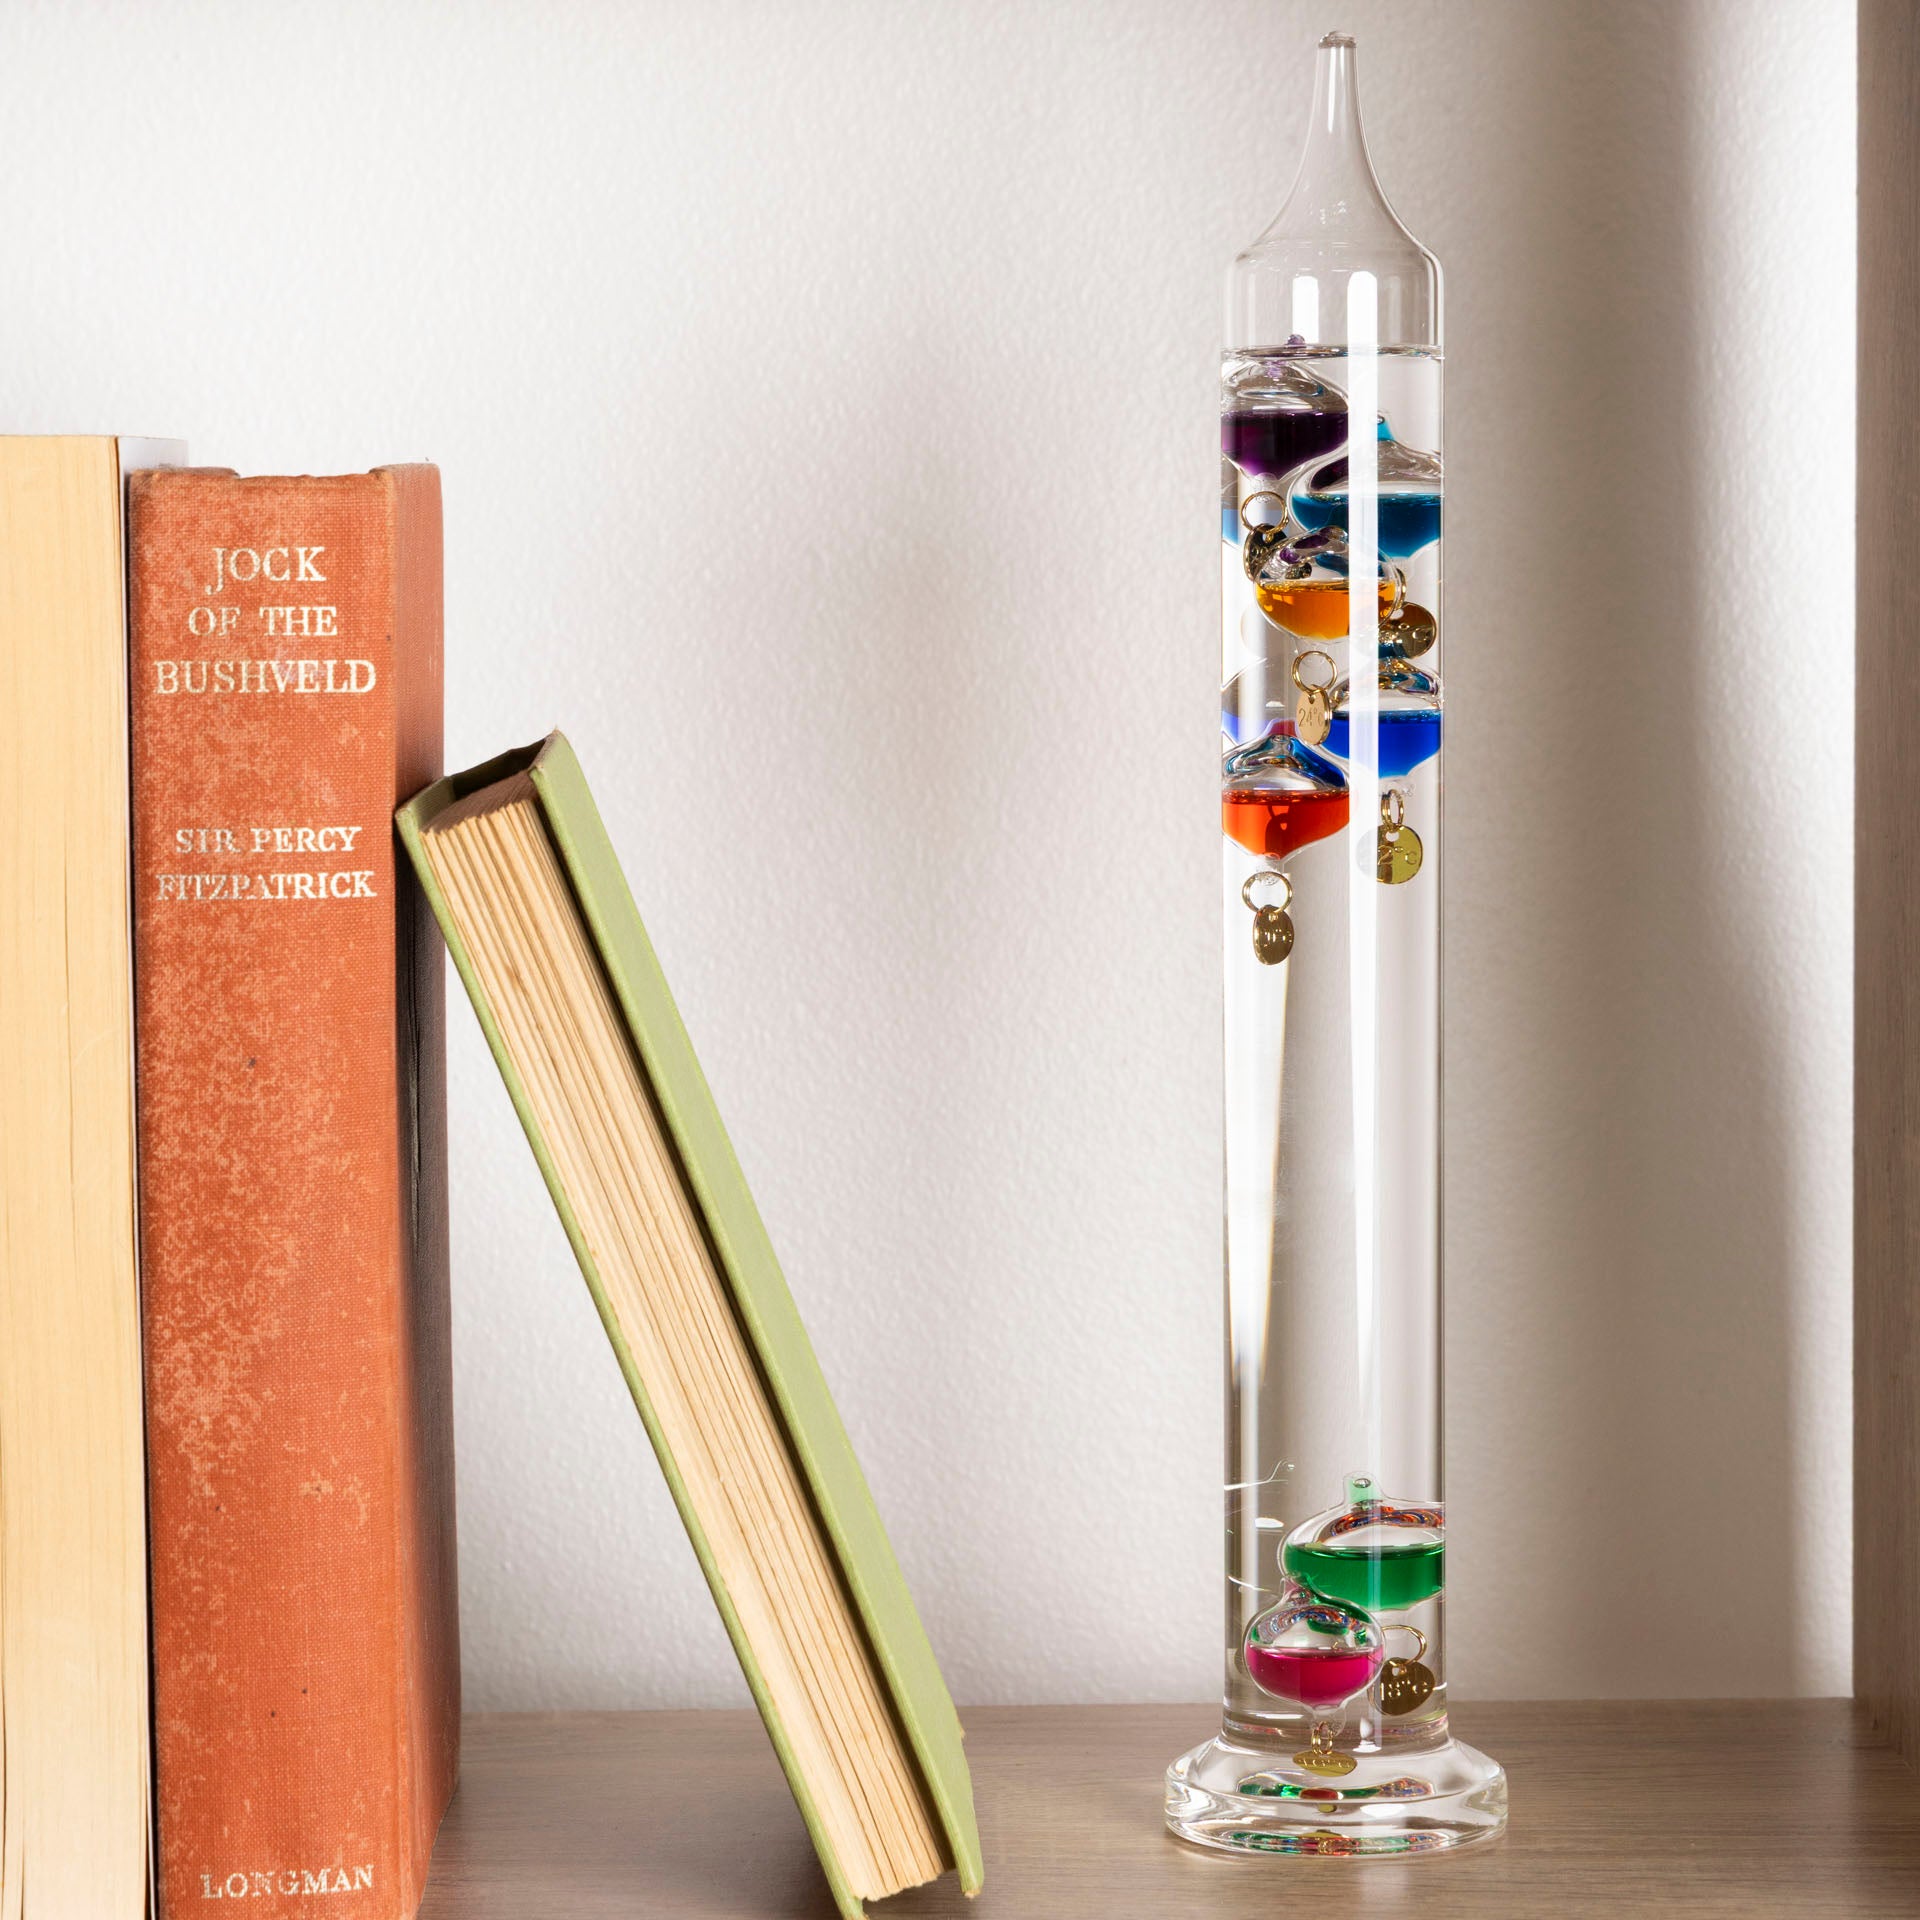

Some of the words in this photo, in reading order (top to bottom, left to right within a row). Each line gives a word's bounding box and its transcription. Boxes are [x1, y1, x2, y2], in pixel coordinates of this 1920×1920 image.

[205, 547, 326, 595] JOCK
[188, 607, 241, 636] OF
[260, 607, 338, 636] THE
[154, 660, 376, 694] BUSHVELD
[176, 828, 241, 853] SIR
[251, 827, 362, 852] PERCY
[157, 870, 376, 900] FITZPATRICK
[200, 1865, 375, 1899] LONGMAN
